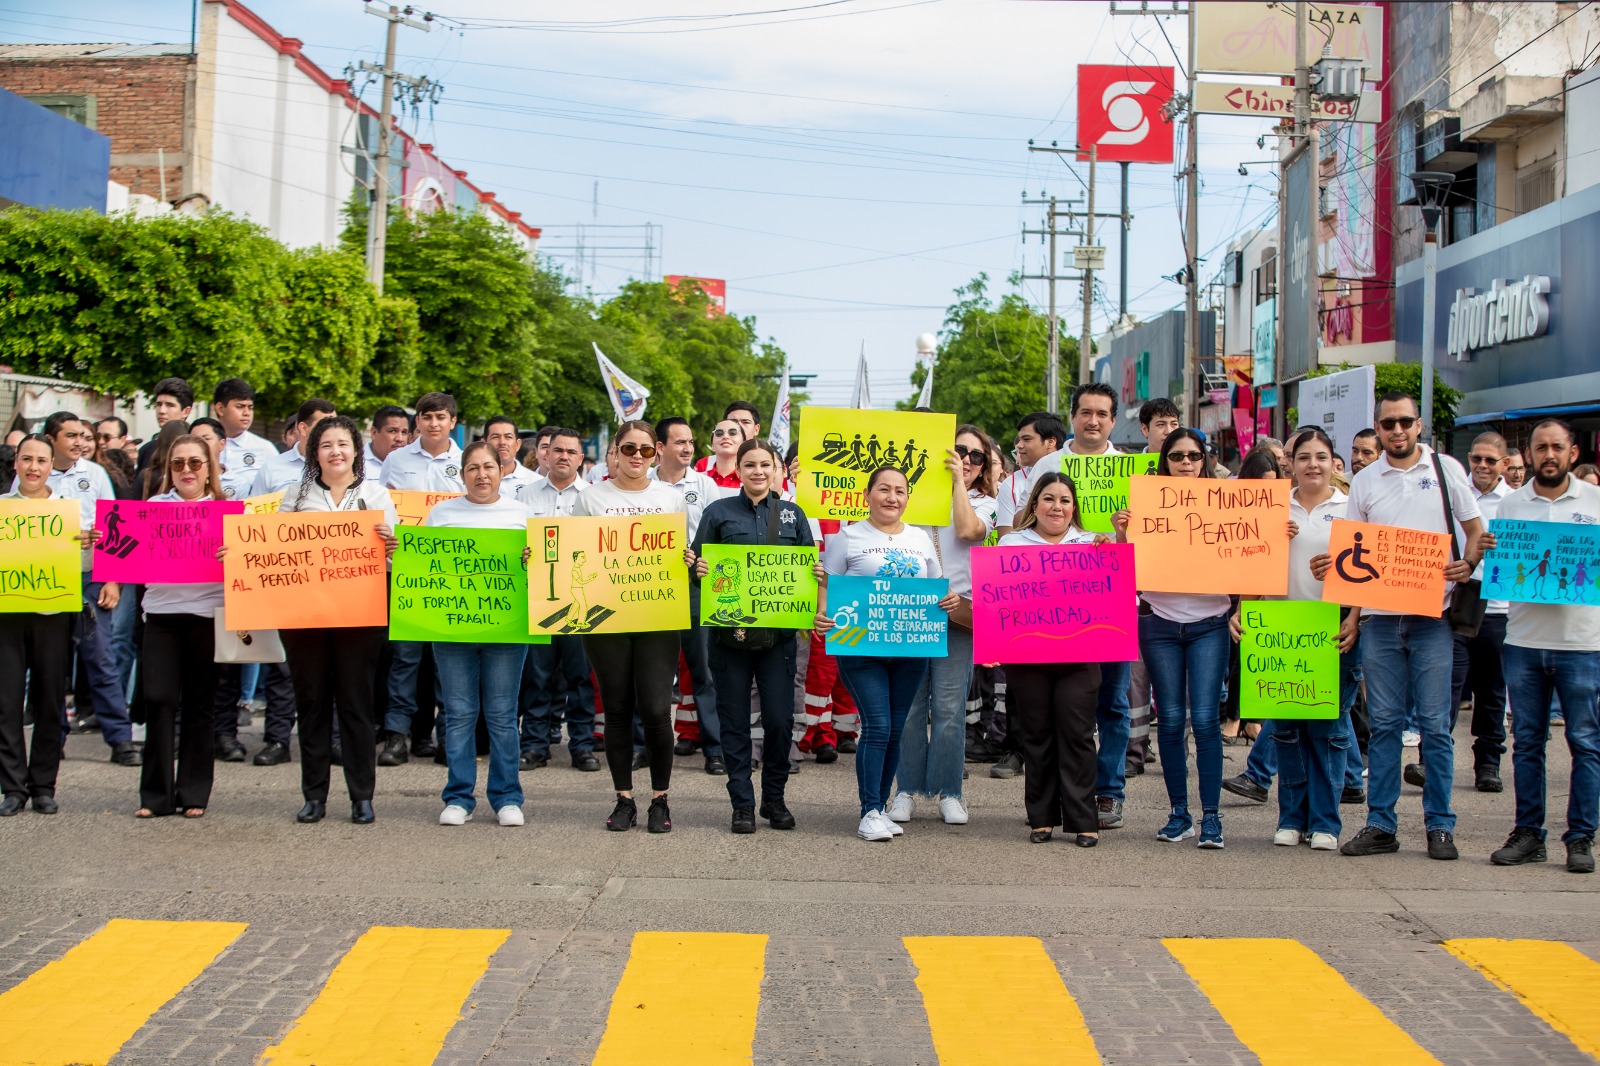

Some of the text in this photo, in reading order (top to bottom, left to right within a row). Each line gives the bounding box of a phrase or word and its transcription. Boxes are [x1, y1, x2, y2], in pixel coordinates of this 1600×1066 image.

[1064, 458, 1080, 479] YO
[812, 471, 856, 490] TODOS
[1090, 480, 1114, 490] PASO
[1077, 495, 1128, 514] ATONA
[1159, 486, 1284, 510] DIA MUNDIAL
[150, 522, 203, 540] SEGURA
[238, 522, 364, 543] UN CONDUCTOR
[1142, 512, 1260, 546] DEL PEATÓN
[402, 532, 480, 554] RESPETAR
[598, 522, 677, 553] NO CRUCE
[1378, 530, 1439, 546] EL RESPETO
[244, 546, 378, 570] PRUDENTE PROTEGE
[1377, 543, 1445, 558] ES MUESTRA
[429, 558, 446, 573] AL
[453, 554, 508, 574] PEATÓN
[604, 554, 664, 570] LA CALLE
[746, 552, 816, 568] RECUERDA
[1000, 547, 1120, 574] LOS PEATONES
[1377, 554, 1390, 564] DE
[232, 578, 252, 592] AL
[258, 568, 310, 588] PEATÓN
[608, 571, 672, 585] VIENDO EL
[747, 570, 797, 584] USAR EL
[1380, 566, 1434, 580] Y EMPIEZA
[396, 574, 451, 590] CUIDAR
[460, 576, 477, 592] LA
[484, 576, 516, 592] VIDA
[748, 586, 794, 596] CRUCE
[872, 580, 890, 592] TU
[982, 575, 1112, 604] SIEMPRE TIENEN
[398, 596, 512, 610] SU FORMA MAS
[620, 588, 676, 602] CELULAR
[868, 592, 938, 606] DISCAPACIDAD
[446, 613, 500, 626] FRAGIL.
[868, 608, 928, 620] NO TIENE
[1246, 611, 1268, 628] EL
[867, 620, 946, 632] QUE SEPARARME
[868, 632, 940, 644] DE LOS DEMAS
[1256, 631, 1333, 650] CONDUCTOR
[1246, 654, 1314, 674] CUIDA AL
